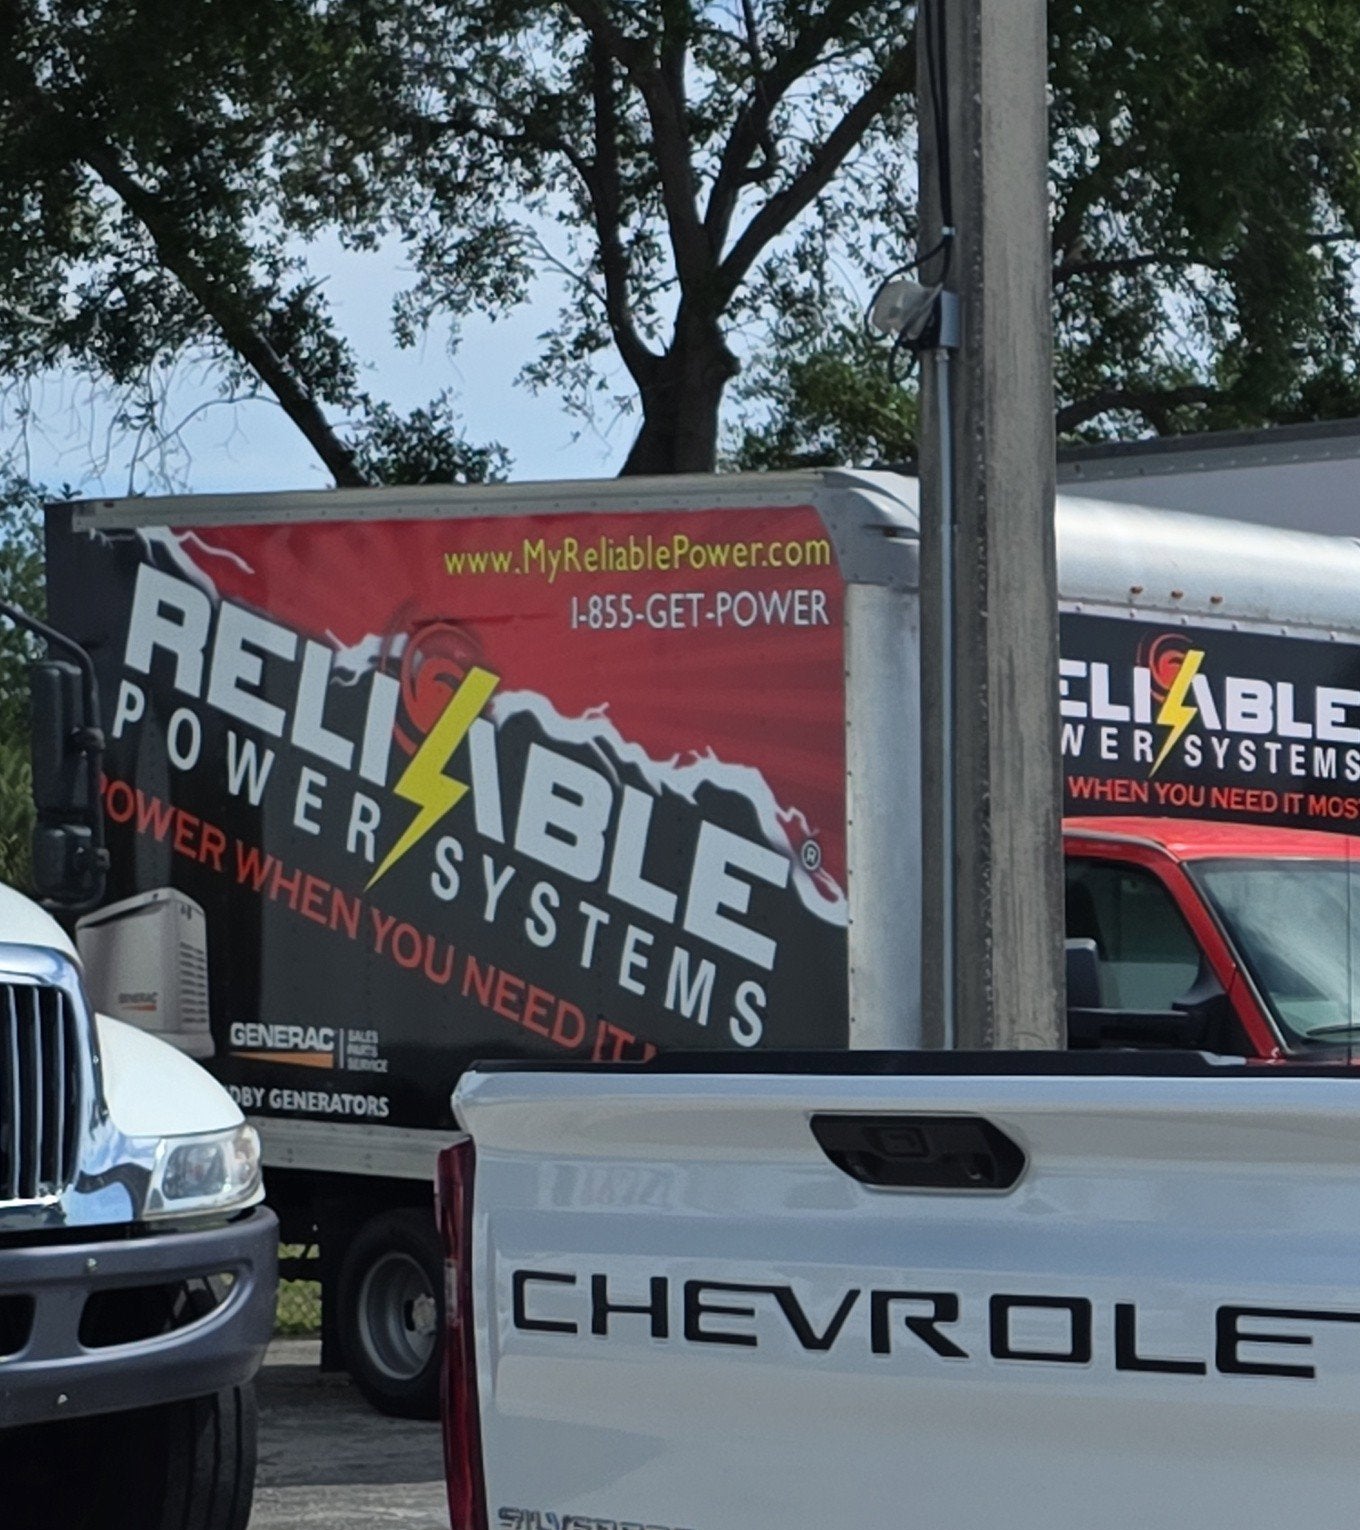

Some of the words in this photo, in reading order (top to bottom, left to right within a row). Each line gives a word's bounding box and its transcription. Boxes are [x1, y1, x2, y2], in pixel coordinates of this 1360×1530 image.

[444, 534, 831, 584] www.MyReliablePower.com
[570, 589, 830, 629] 1-855-GET-POWER
[124, 562, 791, 971] RELIABLE
[1068, 776, 1149, 804] WHEN
[1154, 781, 1205, 808] YOU
[1210, 786, 1278, 813] NEED
[1283, 792, 1304, 815] IT
[111, 679, 381, 863] POWER
[431, 835, 767, 1048] SYSTEMS
[235, 838, 362, 941] WHEN
[370, 907, 455, 986] YOU
[461, 954, 588, 1049] NEED
[591, 1019, 636, 1064] IT
[230, 1021, 335, 1051] GENERAC
[226, 1084, 266, 1108] DBY
[269, 1087, 390, 1118] GENERATORS
